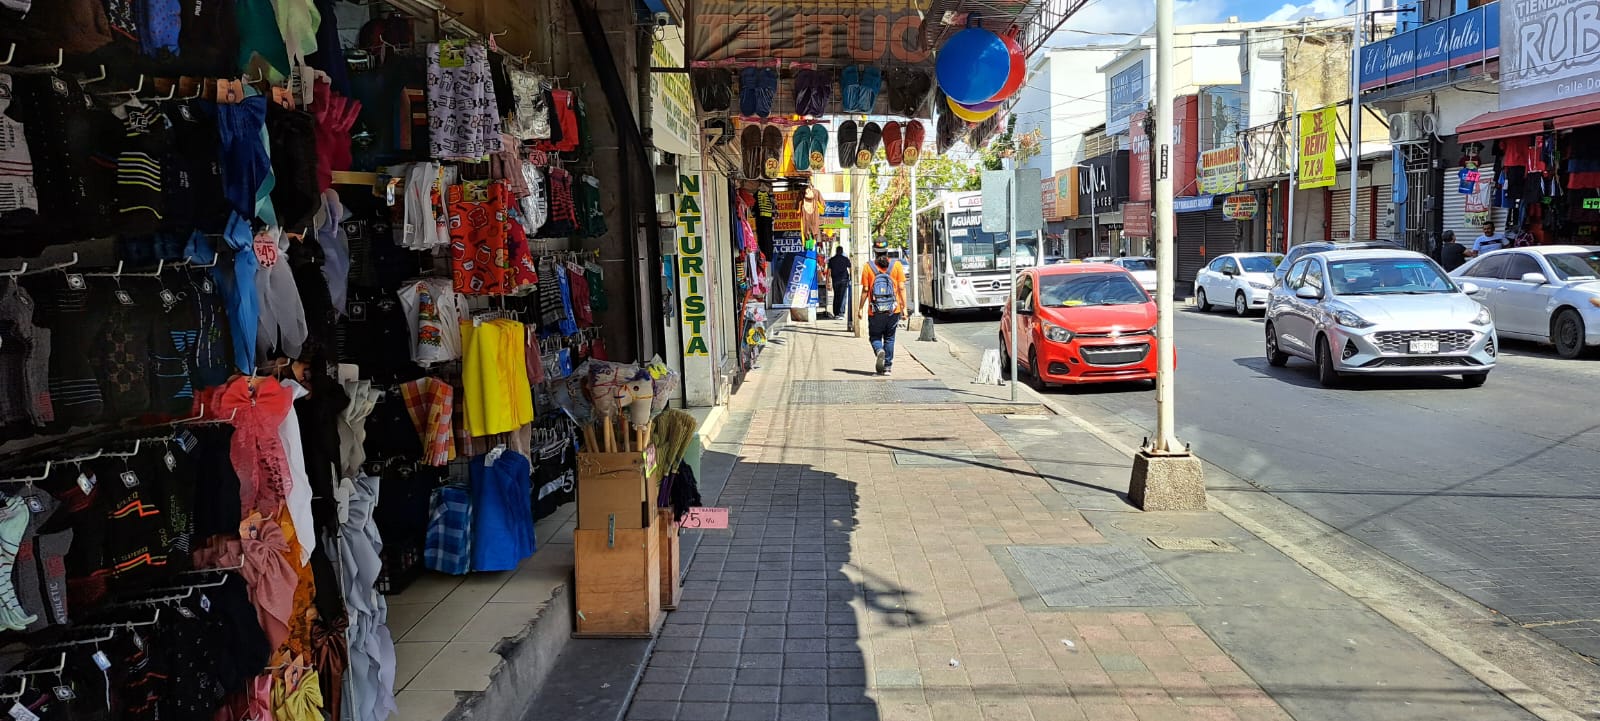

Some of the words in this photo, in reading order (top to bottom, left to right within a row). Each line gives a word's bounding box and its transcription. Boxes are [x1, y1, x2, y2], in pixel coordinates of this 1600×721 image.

[1365, 48, 1378, 75] El
[1380, 44, 1414, 72] Rincon
[1433, 17, 1480, 56] Detalles
[1557, 81, 1583, 97] Calle
[1312, 112, 1323, 133] SE
[1304, 132, 1329, 156] RENTA
[1304, 161, 1309, 177] 7
[967, 195, 982, 205] AG
[678, 174, 709, 356] NATURISTA
[49, 582, 67, 625] ATHLETIC
